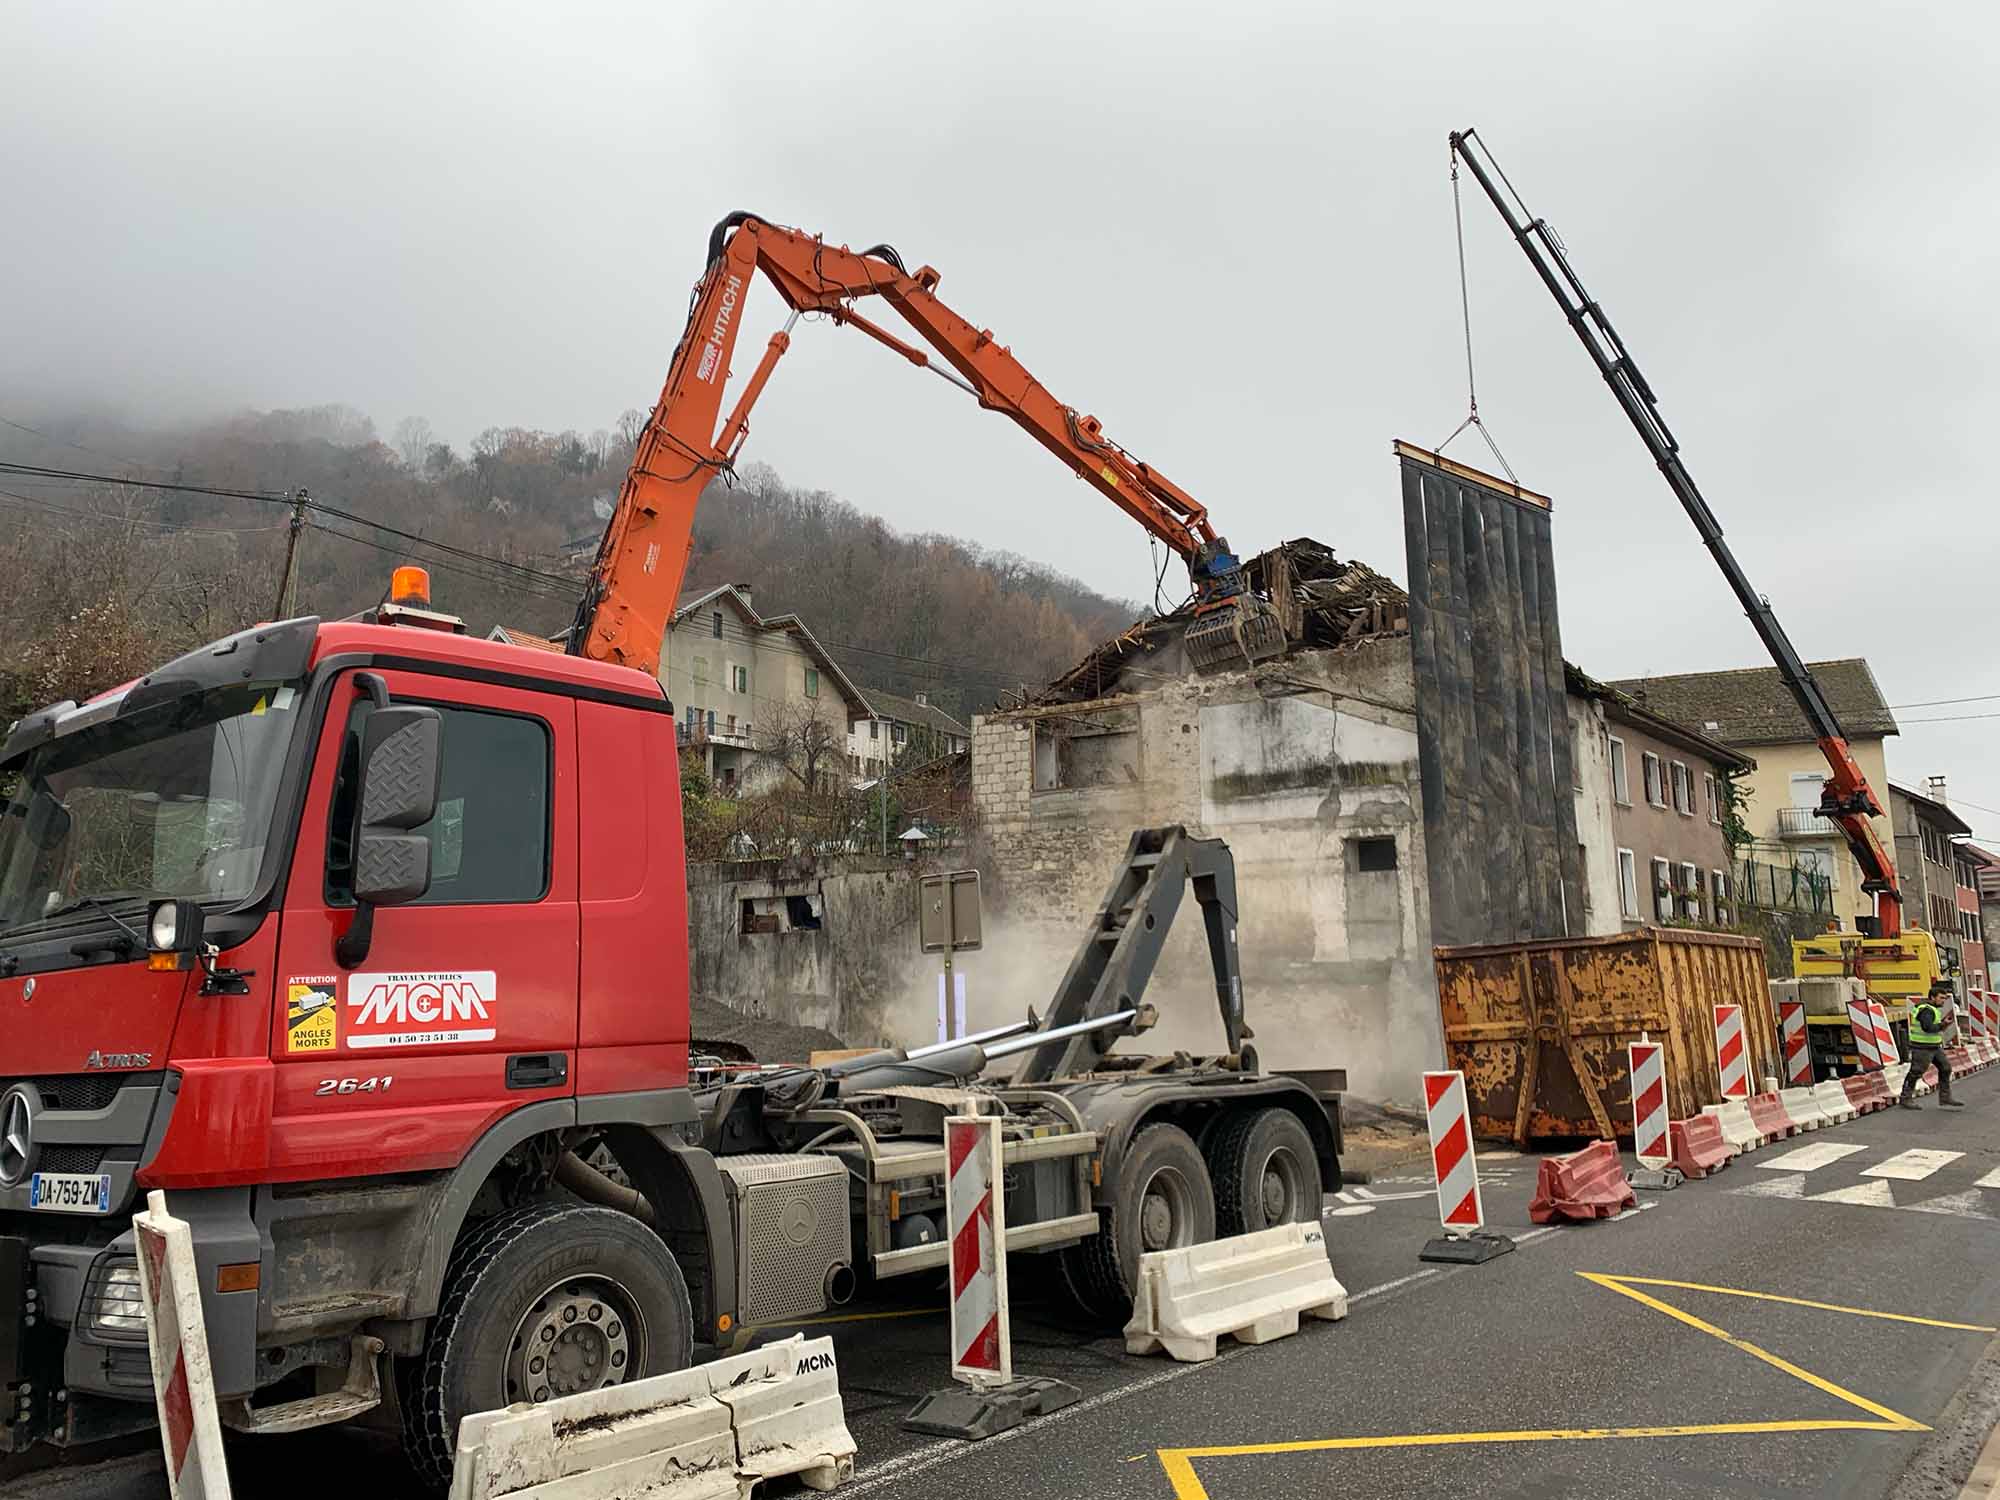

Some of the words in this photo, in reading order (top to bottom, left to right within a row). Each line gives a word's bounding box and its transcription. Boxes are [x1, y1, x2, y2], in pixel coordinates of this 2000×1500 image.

[711, 275, 741, 345] HITACHI
[288, 976, 337, 984] ATTENTION
[387, 974, 425, 982] TRAVAUX
[427, 973, 462, 981] PUBLICS
[355, 983, 489, 1024] MCM
[293, 1029, 331, 1039] ANGLES
[405, 1035, 416, 1043] 50
[420, 1034, 431, 1042] 73
[295, 1038, 330, 1048] MORTS
[315, 1076, 393, 1096] 2641
[796, 1353, 834, 1376] MCM
